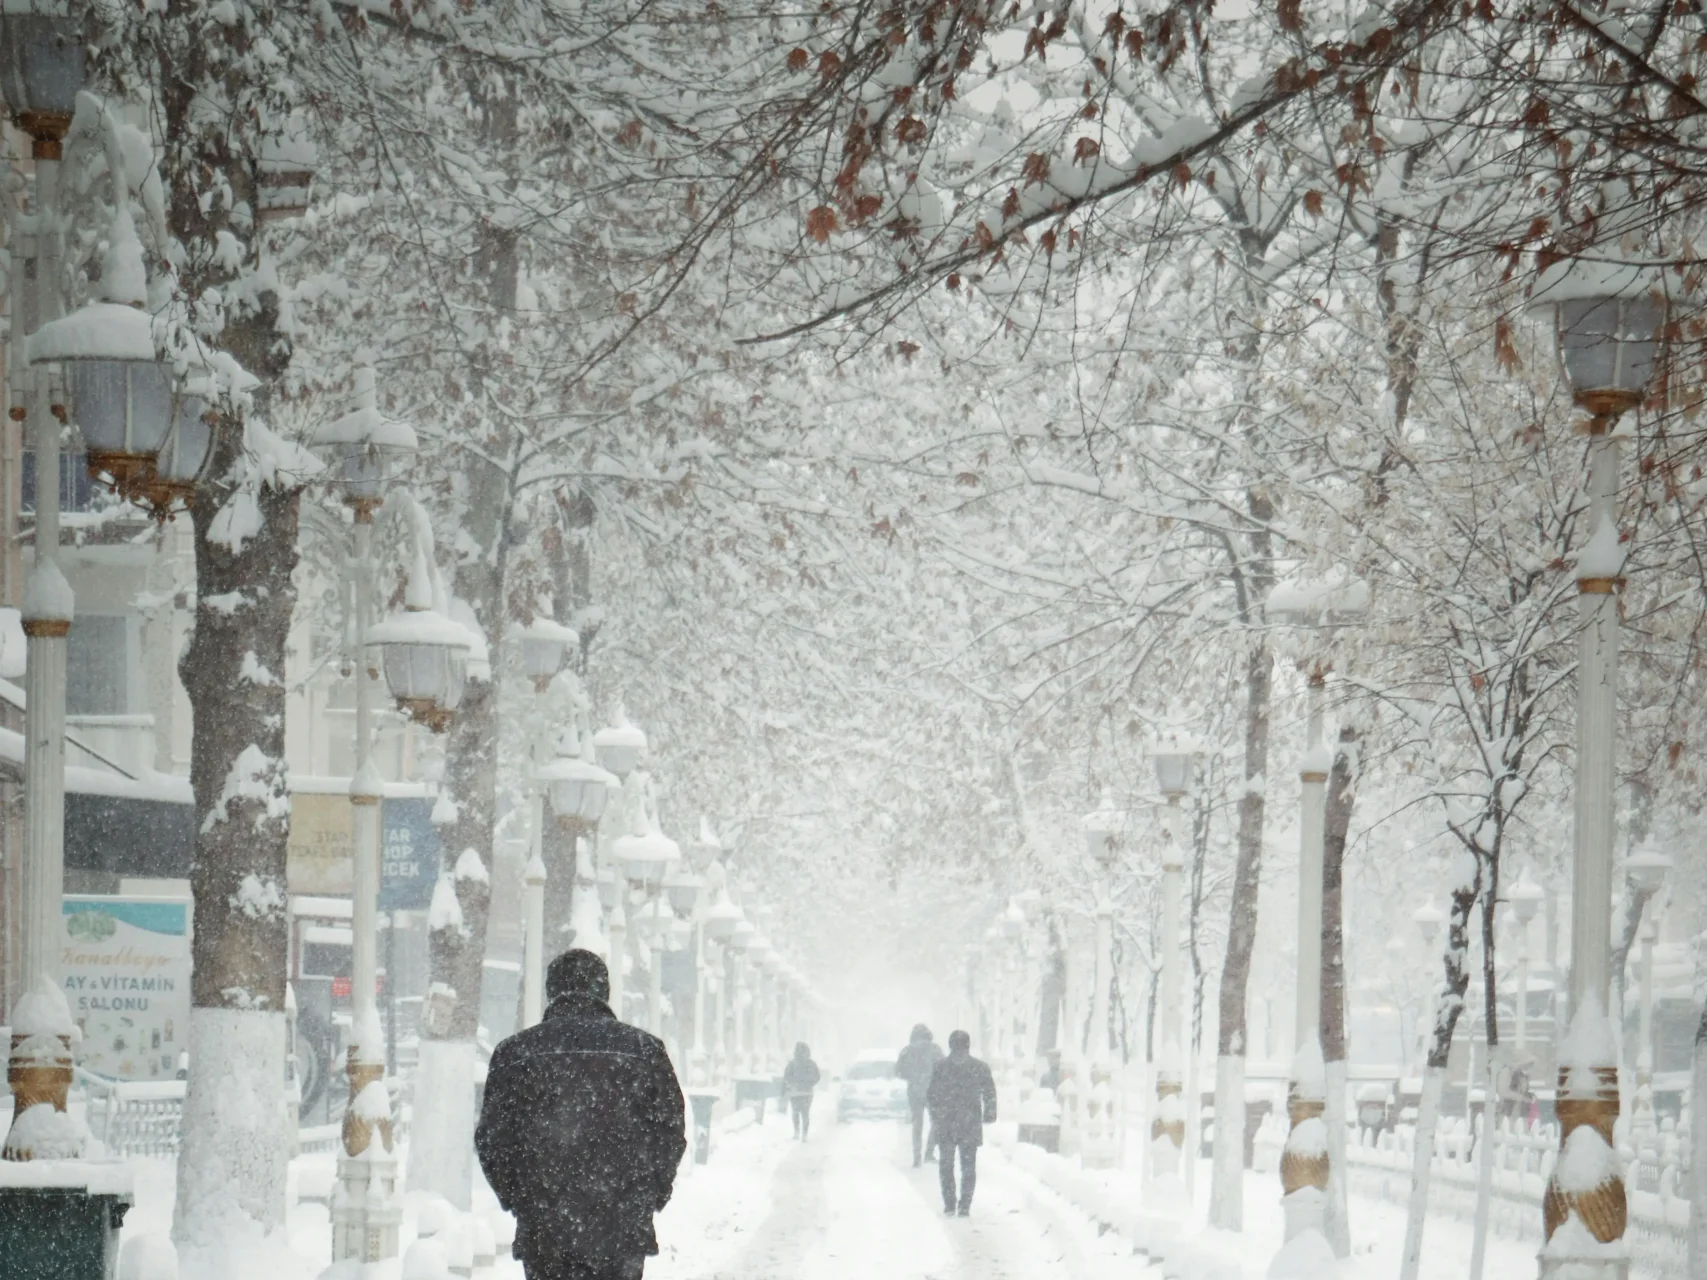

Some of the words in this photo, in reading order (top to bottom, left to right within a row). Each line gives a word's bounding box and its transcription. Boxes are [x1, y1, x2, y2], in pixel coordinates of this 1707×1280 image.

[383, 827, 411, 843] TAR
[383, 861, 420, 878] CEK
[65, 976, 87, 990] AY
[100, 974, 175, 991] VİTAMİN
[78, 996, 148, 1011] SALONU
